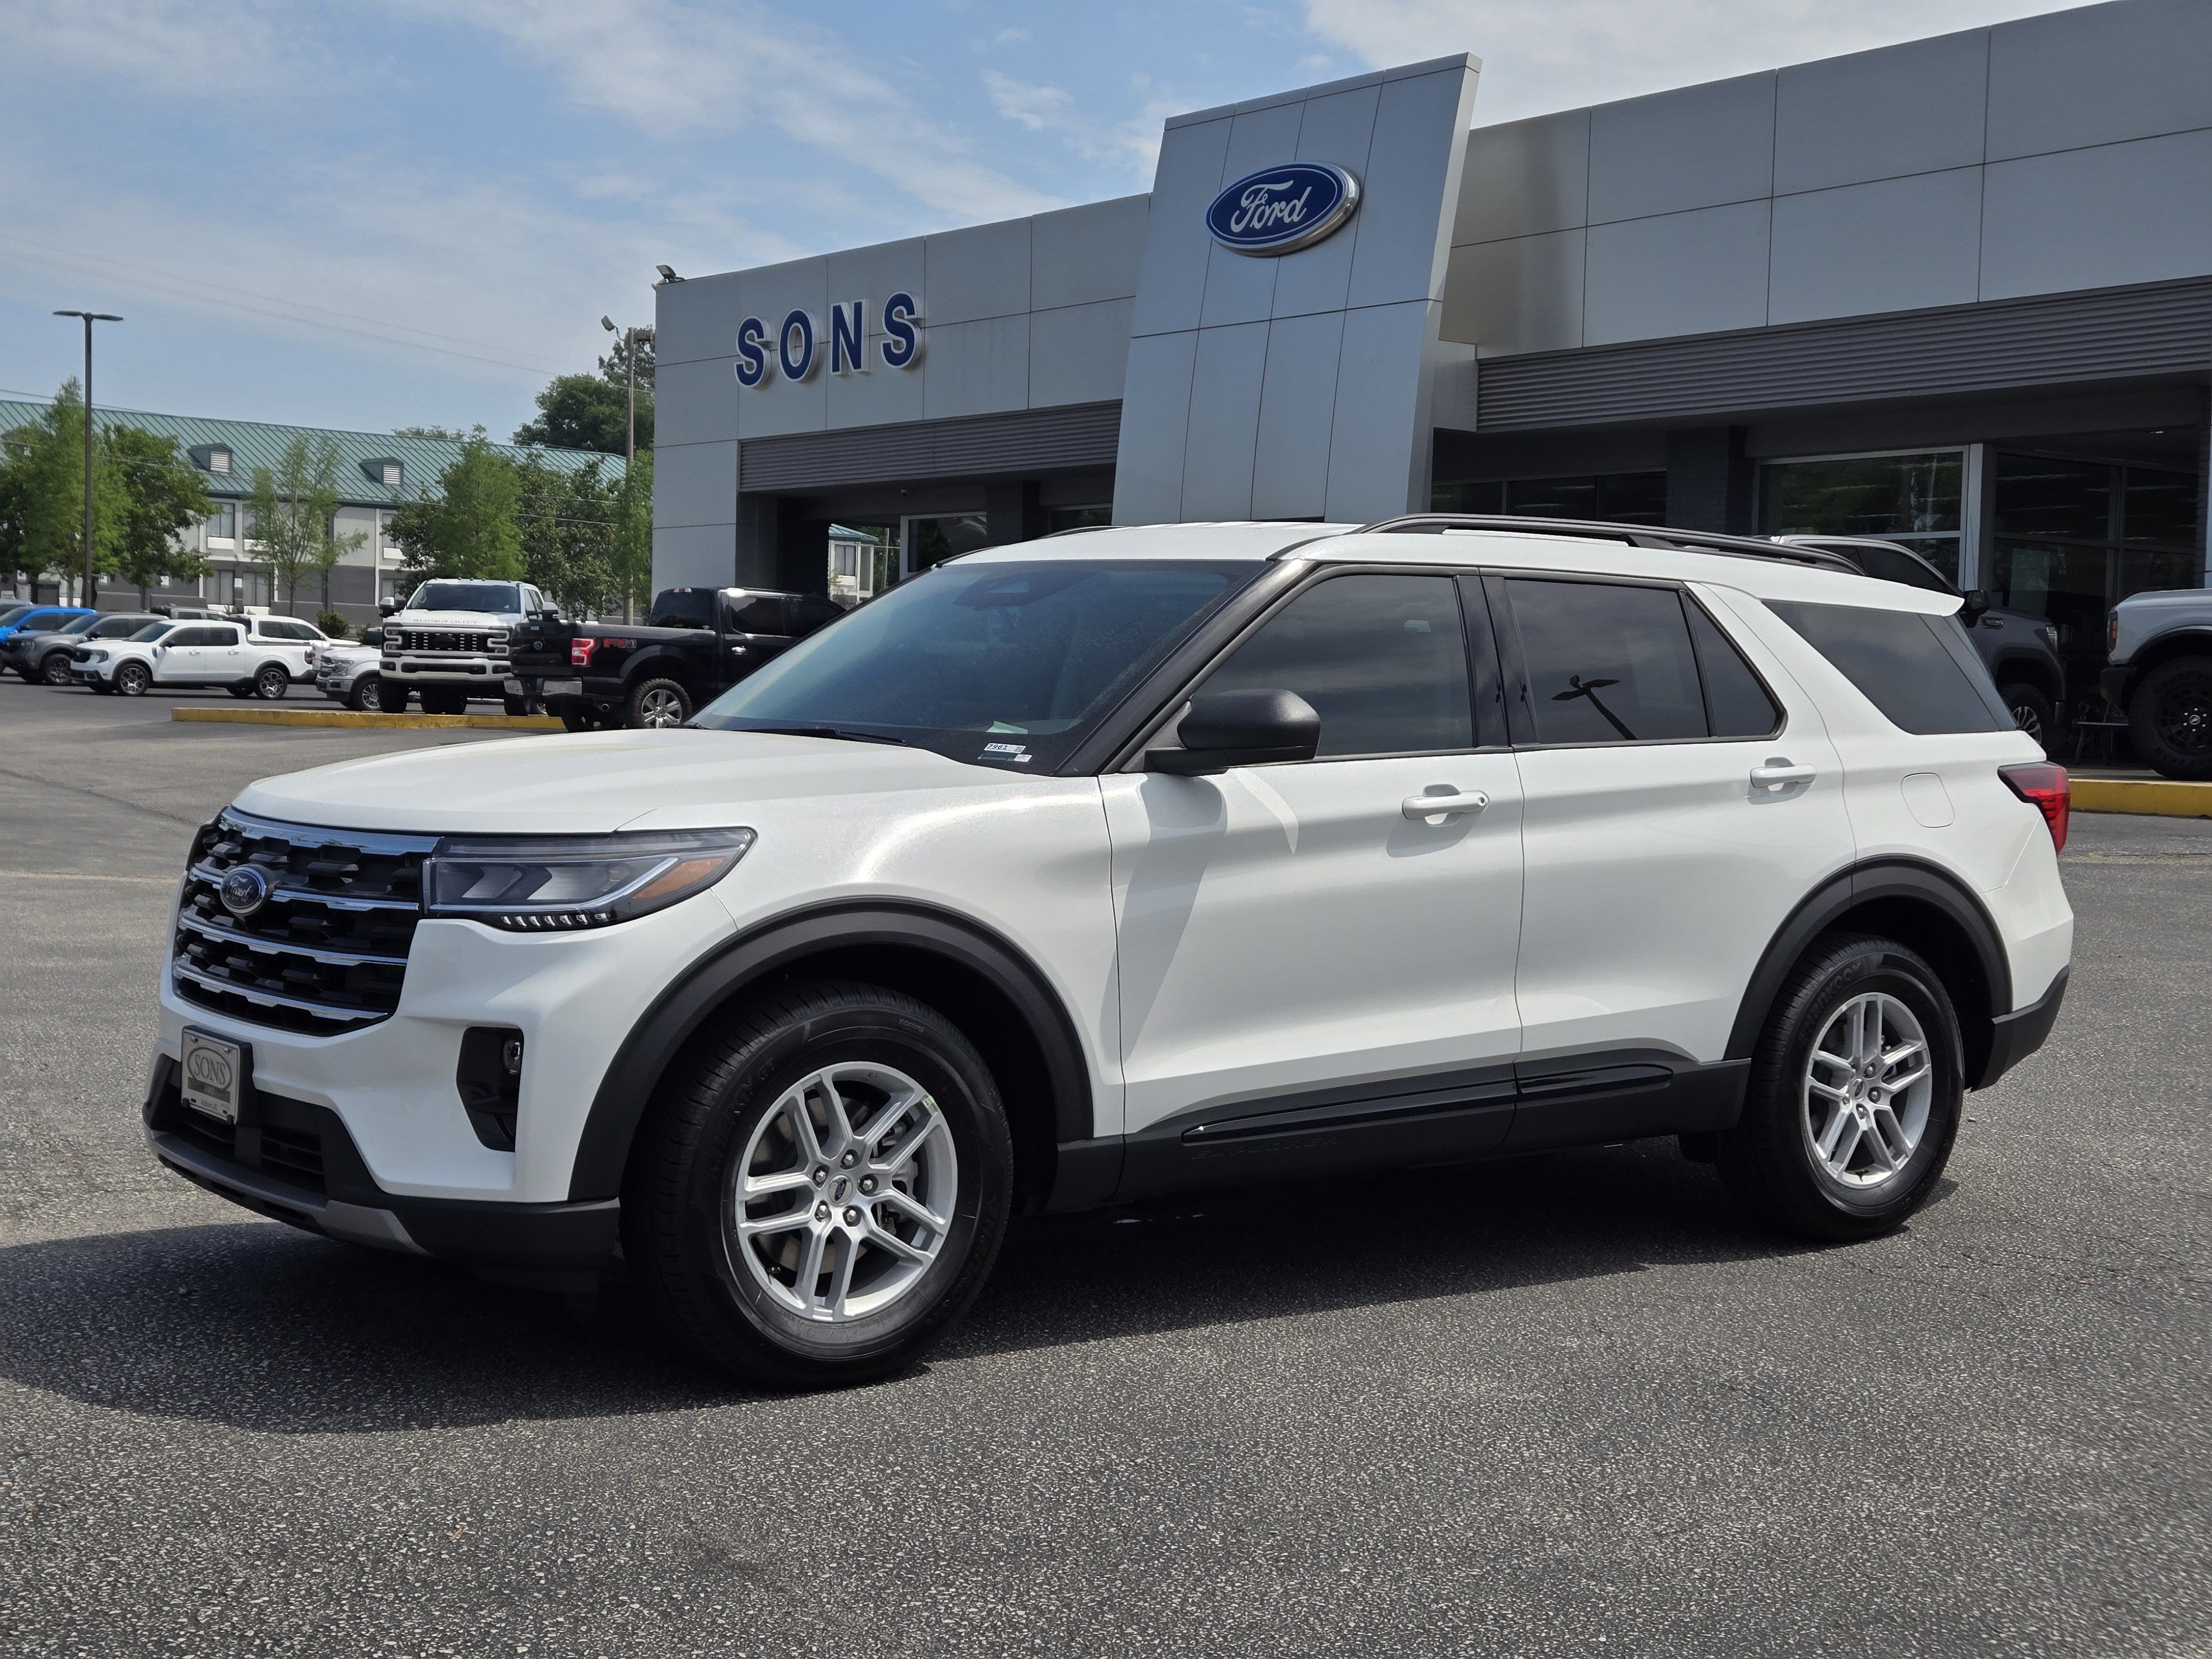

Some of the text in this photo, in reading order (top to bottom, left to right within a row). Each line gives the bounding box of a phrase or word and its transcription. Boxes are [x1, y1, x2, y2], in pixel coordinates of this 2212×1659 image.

[1230, 179, 1312, 233] Ford
[734, 290, 924, 389] SONS
[603, 638, 637, 649] FX4
[225, 875, 252, 902] Ford
[194, 1054, 226, 1085] SONS
